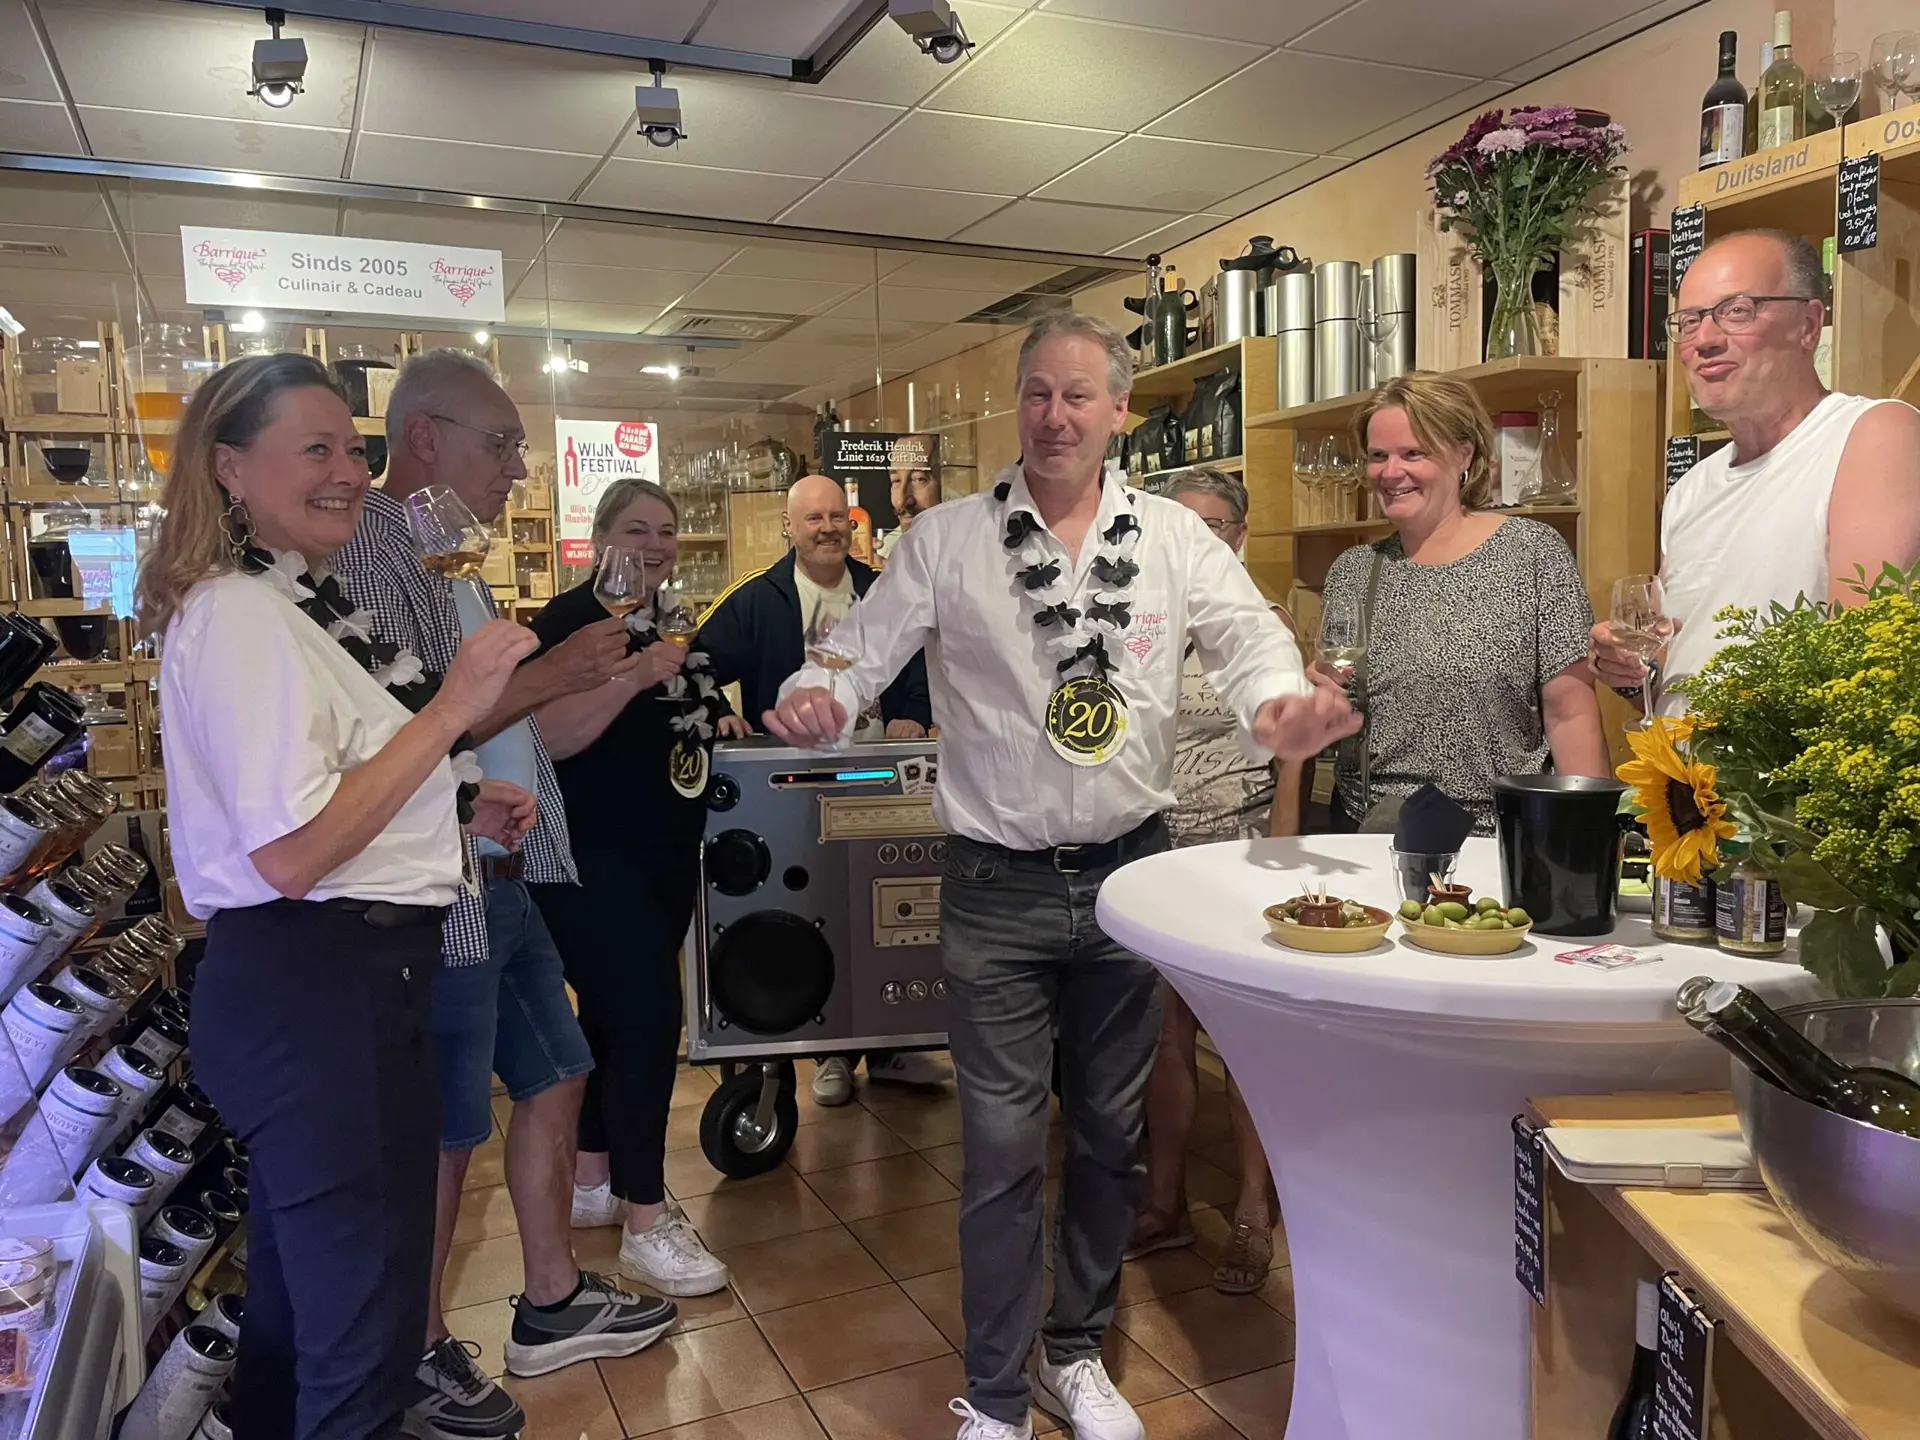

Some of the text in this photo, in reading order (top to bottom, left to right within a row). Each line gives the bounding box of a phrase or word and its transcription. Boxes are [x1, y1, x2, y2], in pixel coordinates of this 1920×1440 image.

[1715, 143, 1809, 194] Duitsland
[193, 240, 268, 261] Barrique
[291, 252, 408, 276] Sinds 2005
[429, 257, 495, 278] Barrique
[1592, 238, 1606, 312] TOMMASI
[278, 277, 423, 299] Culinair & Cadeau
[578, 443, 613, 457] WIJN
[619, 433, 649, 446] PARADE
[840, 439, 925, 452] Frederik Hendrik
[581, 459, 641, 473] FESTIVAL
[837, 451, 929, 463] Linie 1629 Gift Box
[1063, 701, 1113, 738] 20
[679, 750, 700, 779] 20
[1661, 1325, 1684, 1361] Drift
[1660, 1351, 1694, 1399] Chenin
[1667, 1375, 1693, 1419] blanc
